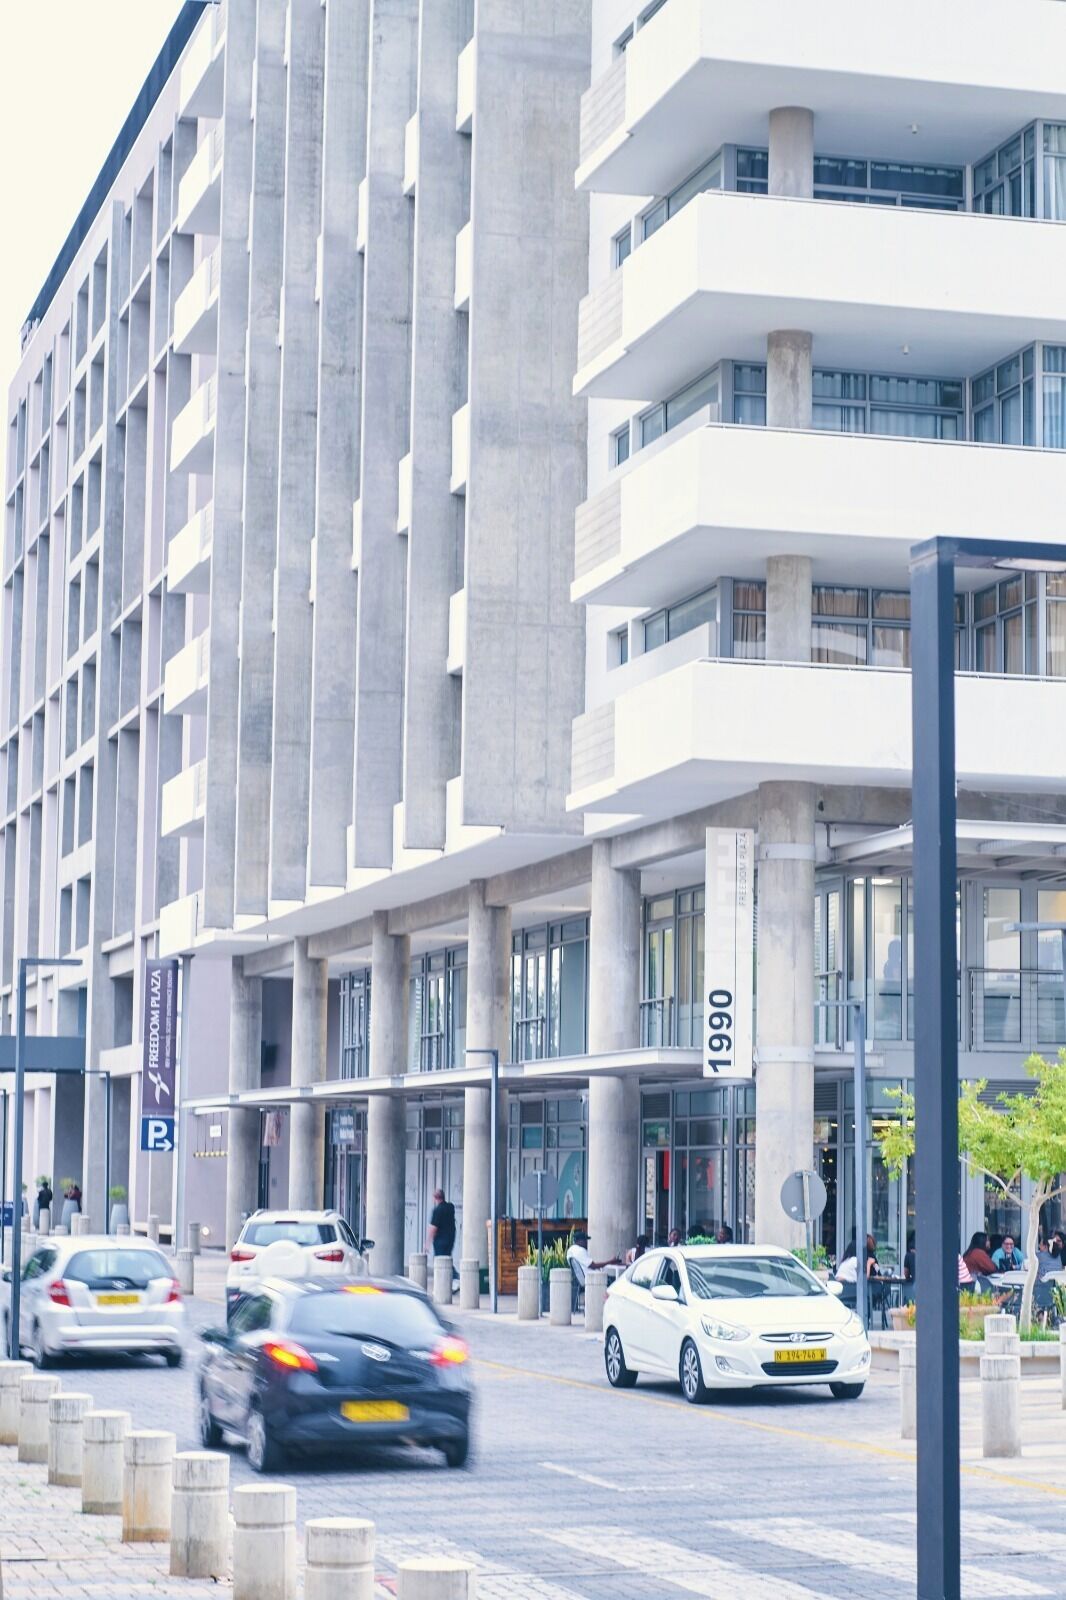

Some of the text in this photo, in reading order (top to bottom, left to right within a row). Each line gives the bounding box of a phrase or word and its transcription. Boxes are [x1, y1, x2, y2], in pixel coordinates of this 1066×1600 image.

[148, 969, 161, 1068] FREEDOM PLAZA
[708, 988, 733, 1074] 1990
[147, 1119, 168, 1149] P
